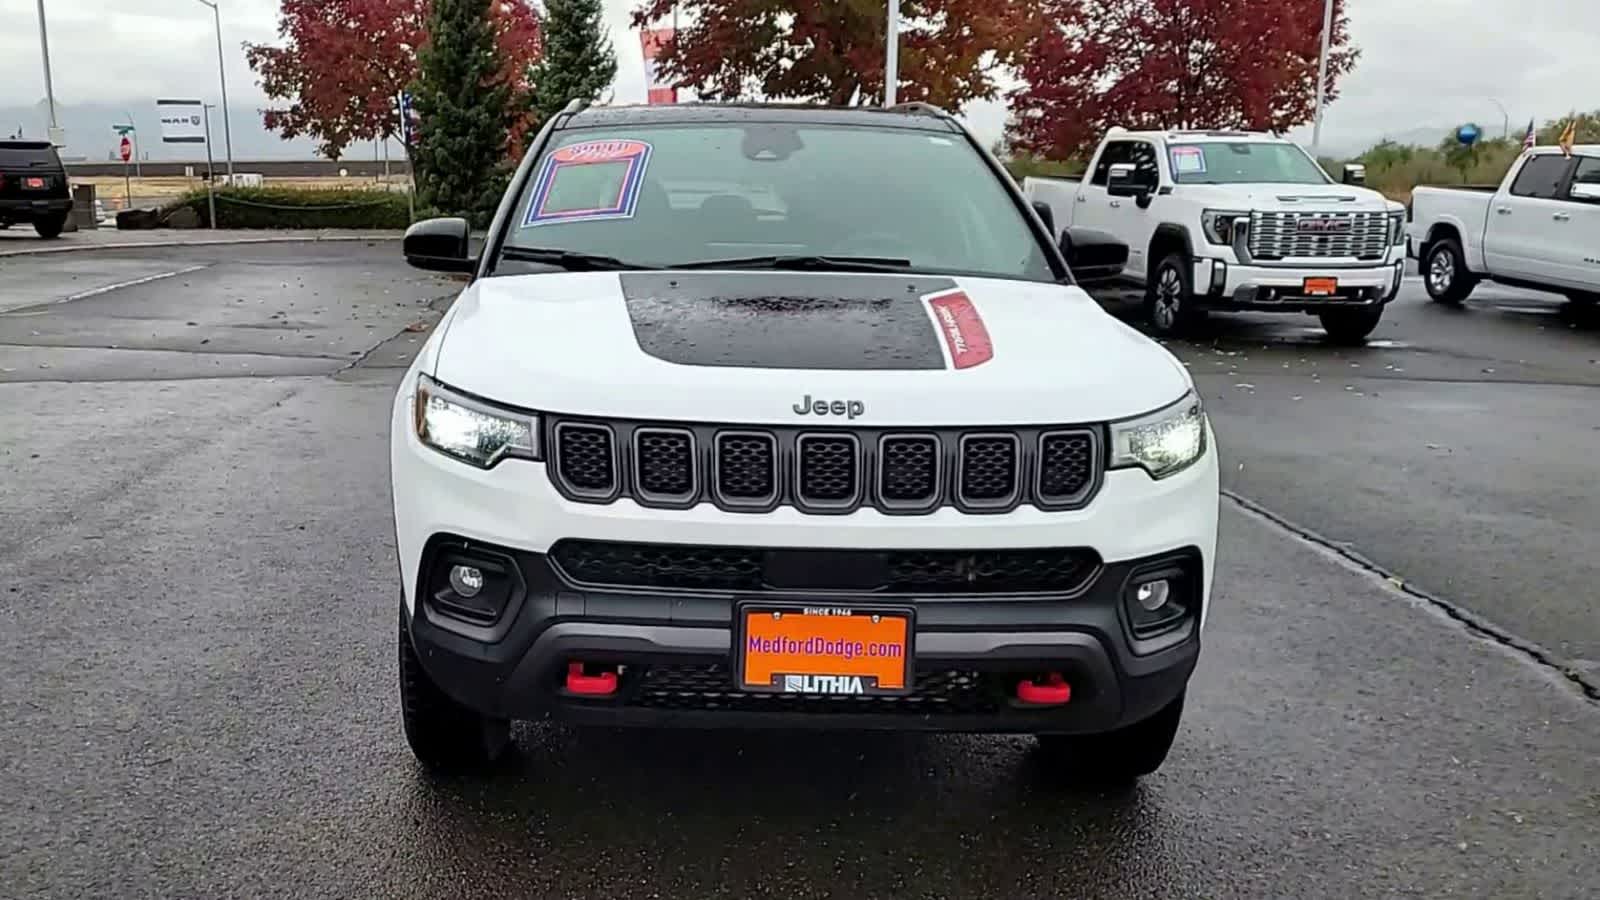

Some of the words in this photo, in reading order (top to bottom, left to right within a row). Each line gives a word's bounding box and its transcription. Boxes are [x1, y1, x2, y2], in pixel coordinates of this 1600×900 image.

[1300, 220, 1351, 231] GMC
[792, 394, 865, 420] Jeep
[803, 607, 829, 616] SINCE
[749, 635, 902, 659] MedfordDodge.com
[803, 676, 864, 694] LITHIA
